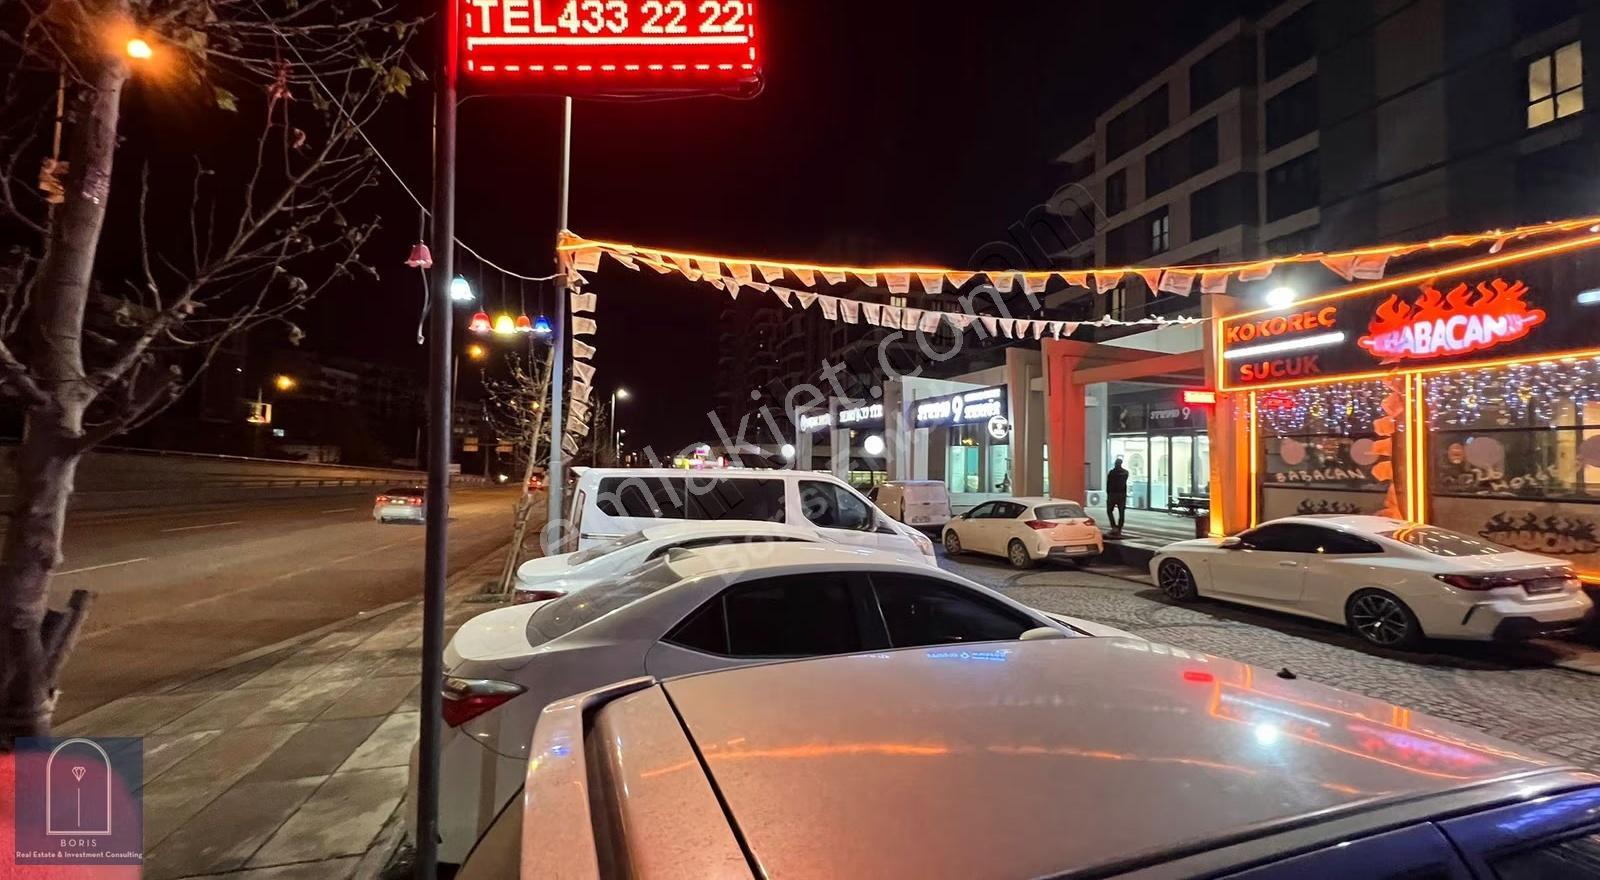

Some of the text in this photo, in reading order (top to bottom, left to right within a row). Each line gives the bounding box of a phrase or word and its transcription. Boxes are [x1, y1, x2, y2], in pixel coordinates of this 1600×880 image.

[641, 1, 687, 34] 22
[698, 0, 745, 33] 22
[1226, 306, 1337, 343] KOKOREÇ
[1240, 355, 1320, 381] SUCUK
[952, 395, 963, 423] 9
